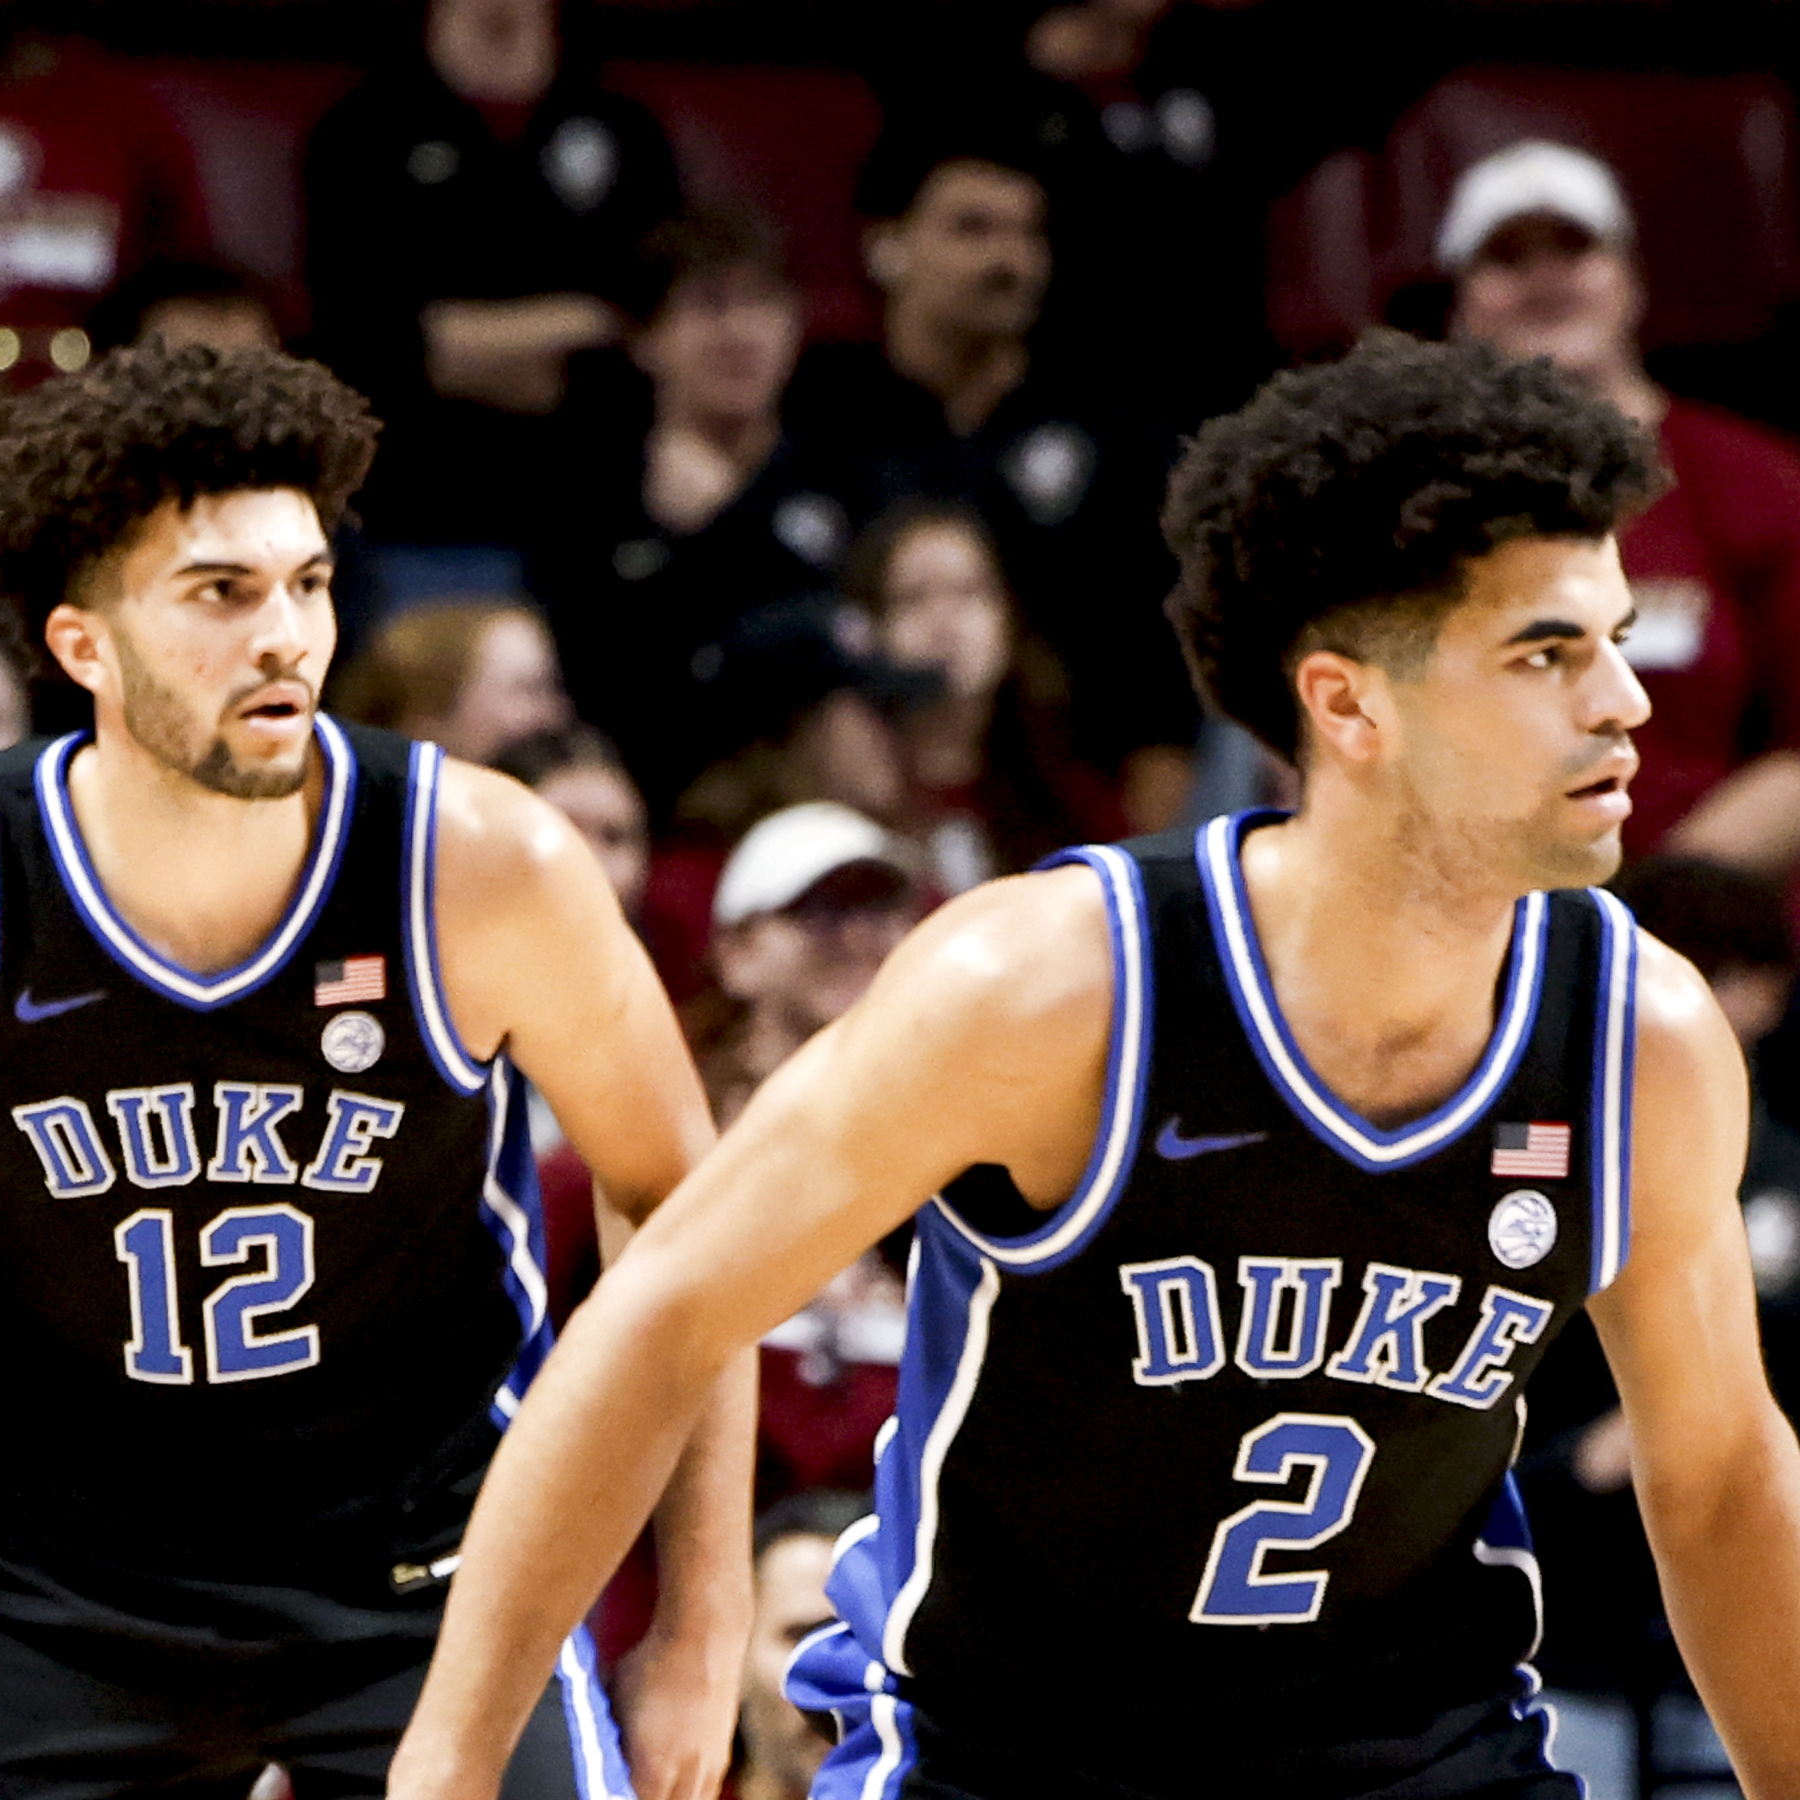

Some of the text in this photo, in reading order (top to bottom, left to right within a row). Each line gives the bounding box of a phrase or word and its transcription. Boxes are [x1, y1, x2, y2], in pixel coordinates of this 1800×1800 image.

[11, 1081, 405, 1199] DUKE
[114, 1202, 321, 1386] 12
[1119, 1255, 1555, 1412] DUKE
[1188, 1411, 1377, 1626] 2
